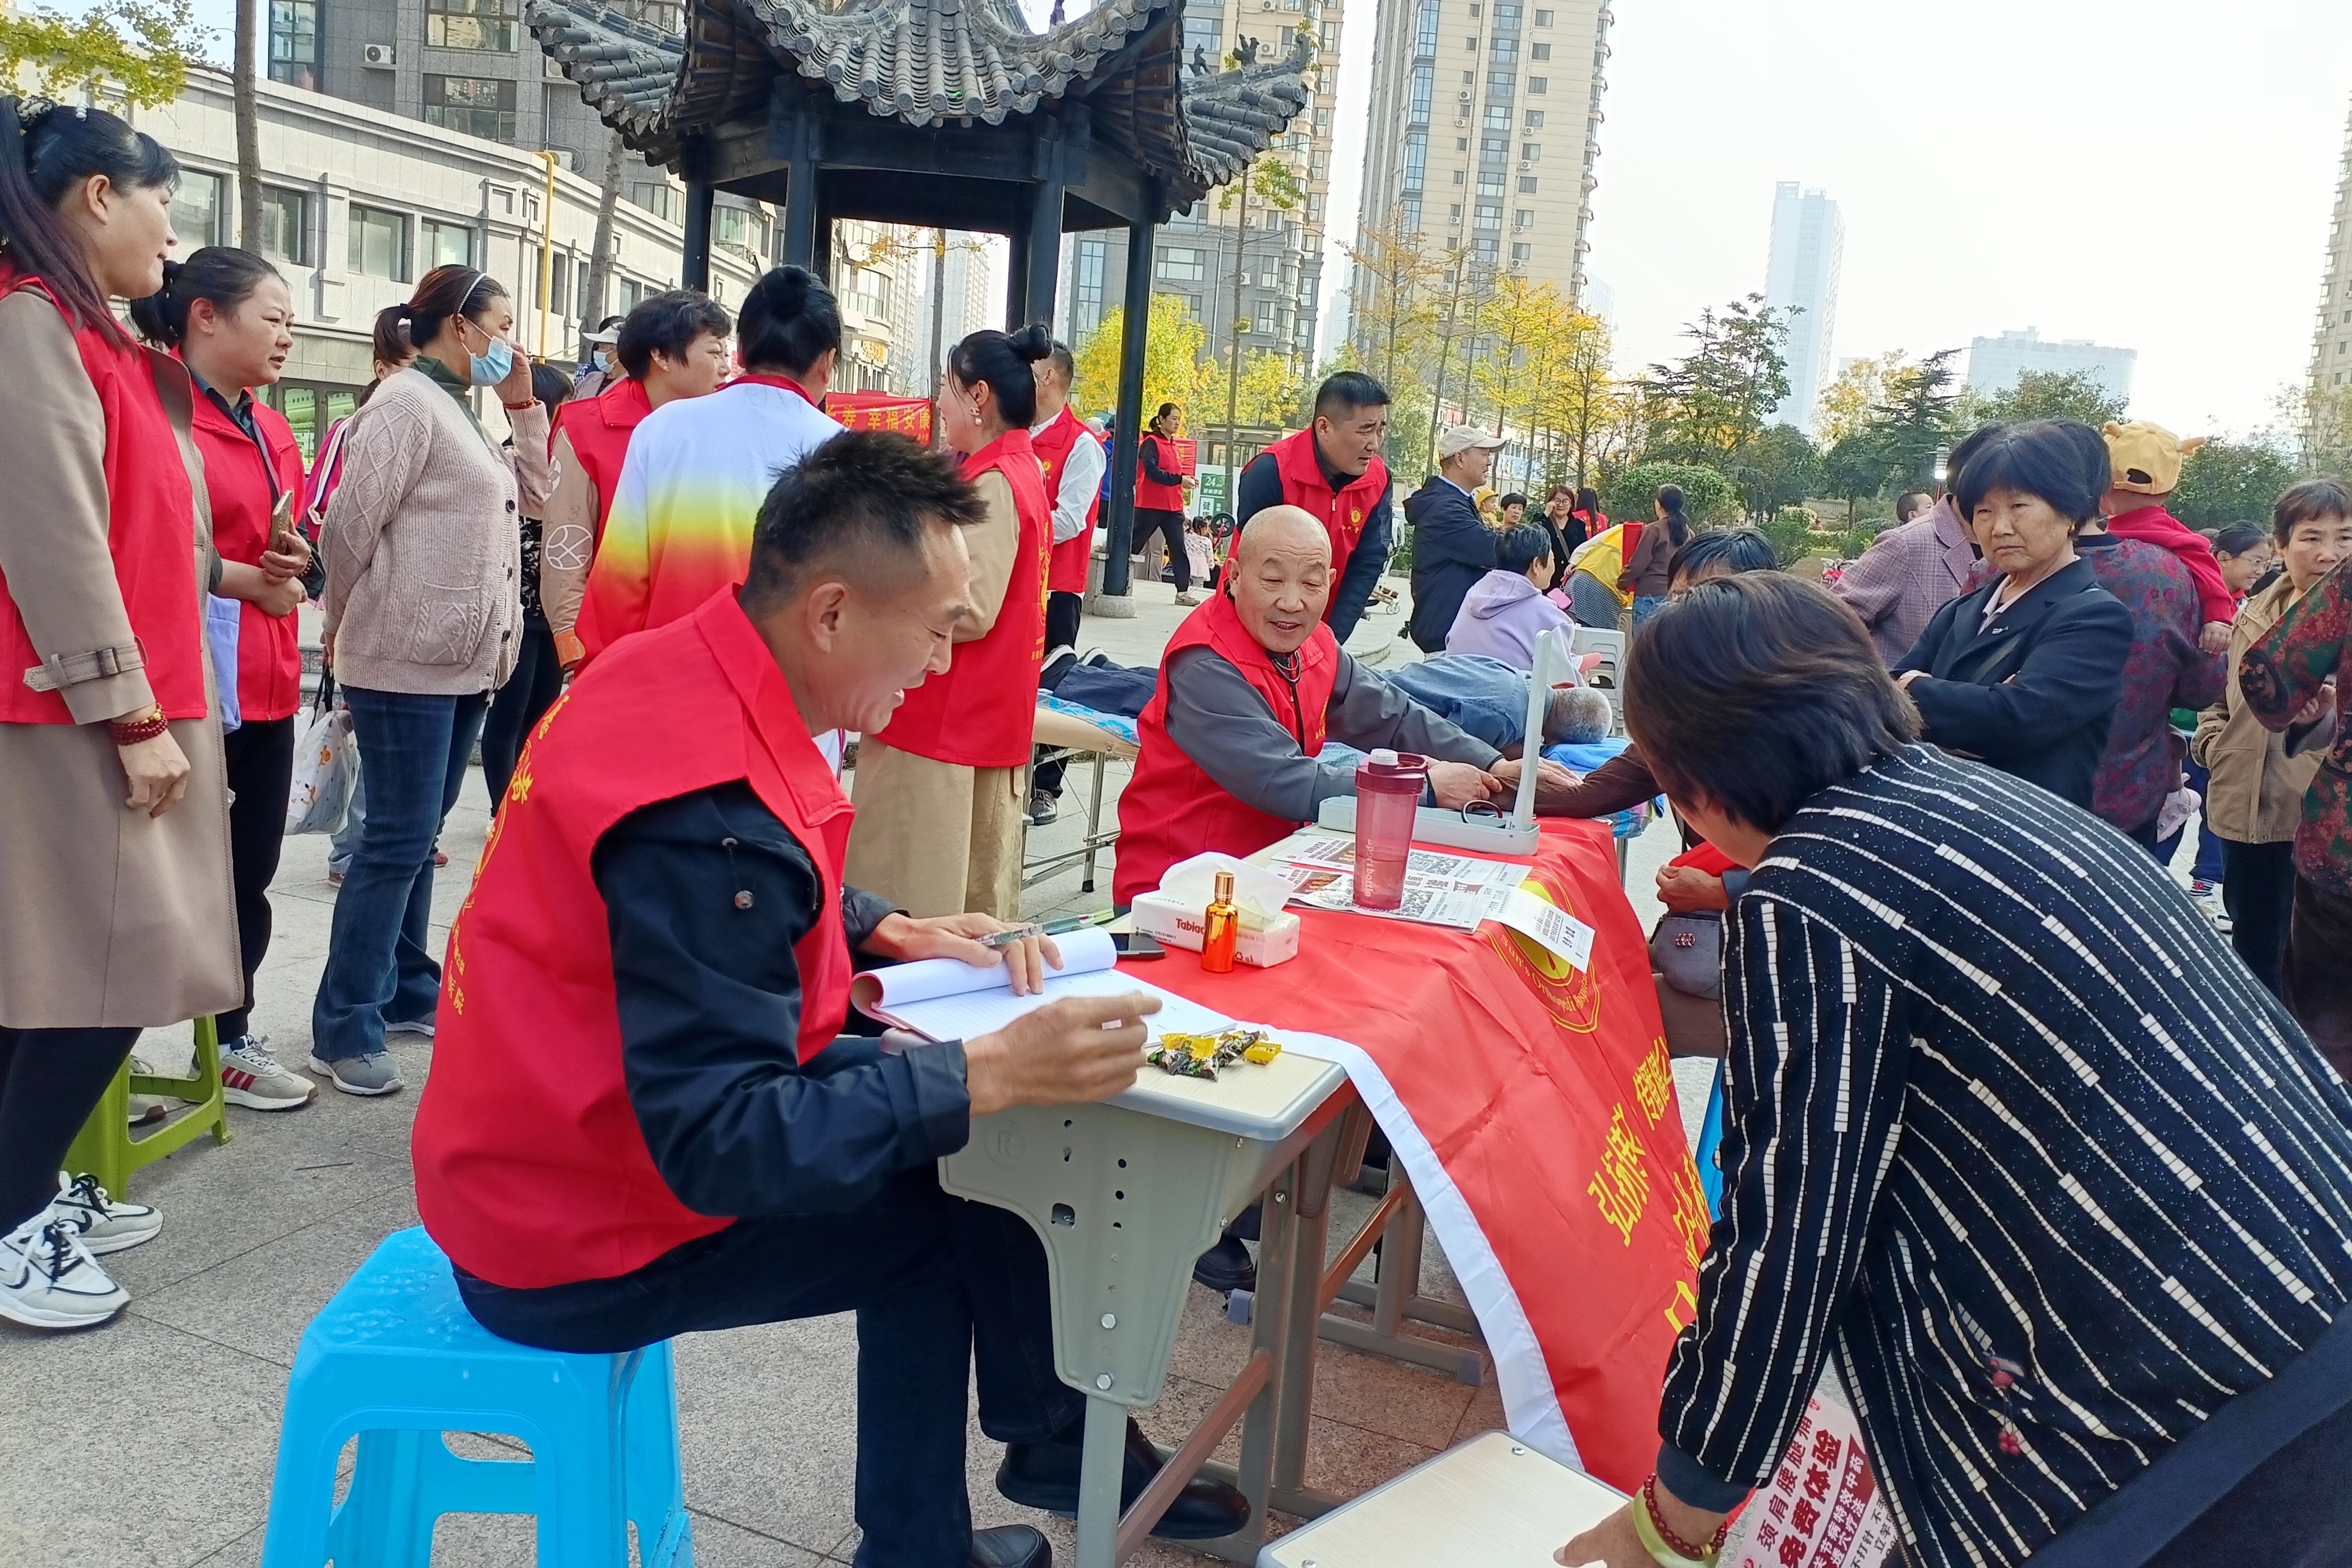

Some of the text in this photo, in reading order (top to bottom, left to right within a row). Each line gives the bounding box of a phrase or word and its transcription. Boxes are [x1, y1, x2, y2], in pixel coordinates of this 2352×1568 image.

[868, 406, 931, 431] 幸福安康
[1205, 476, 1216, 486] 24
[1364, 868, 1375, 897] bottle
[1778, 1429, 1842, 1568] 免费体验
